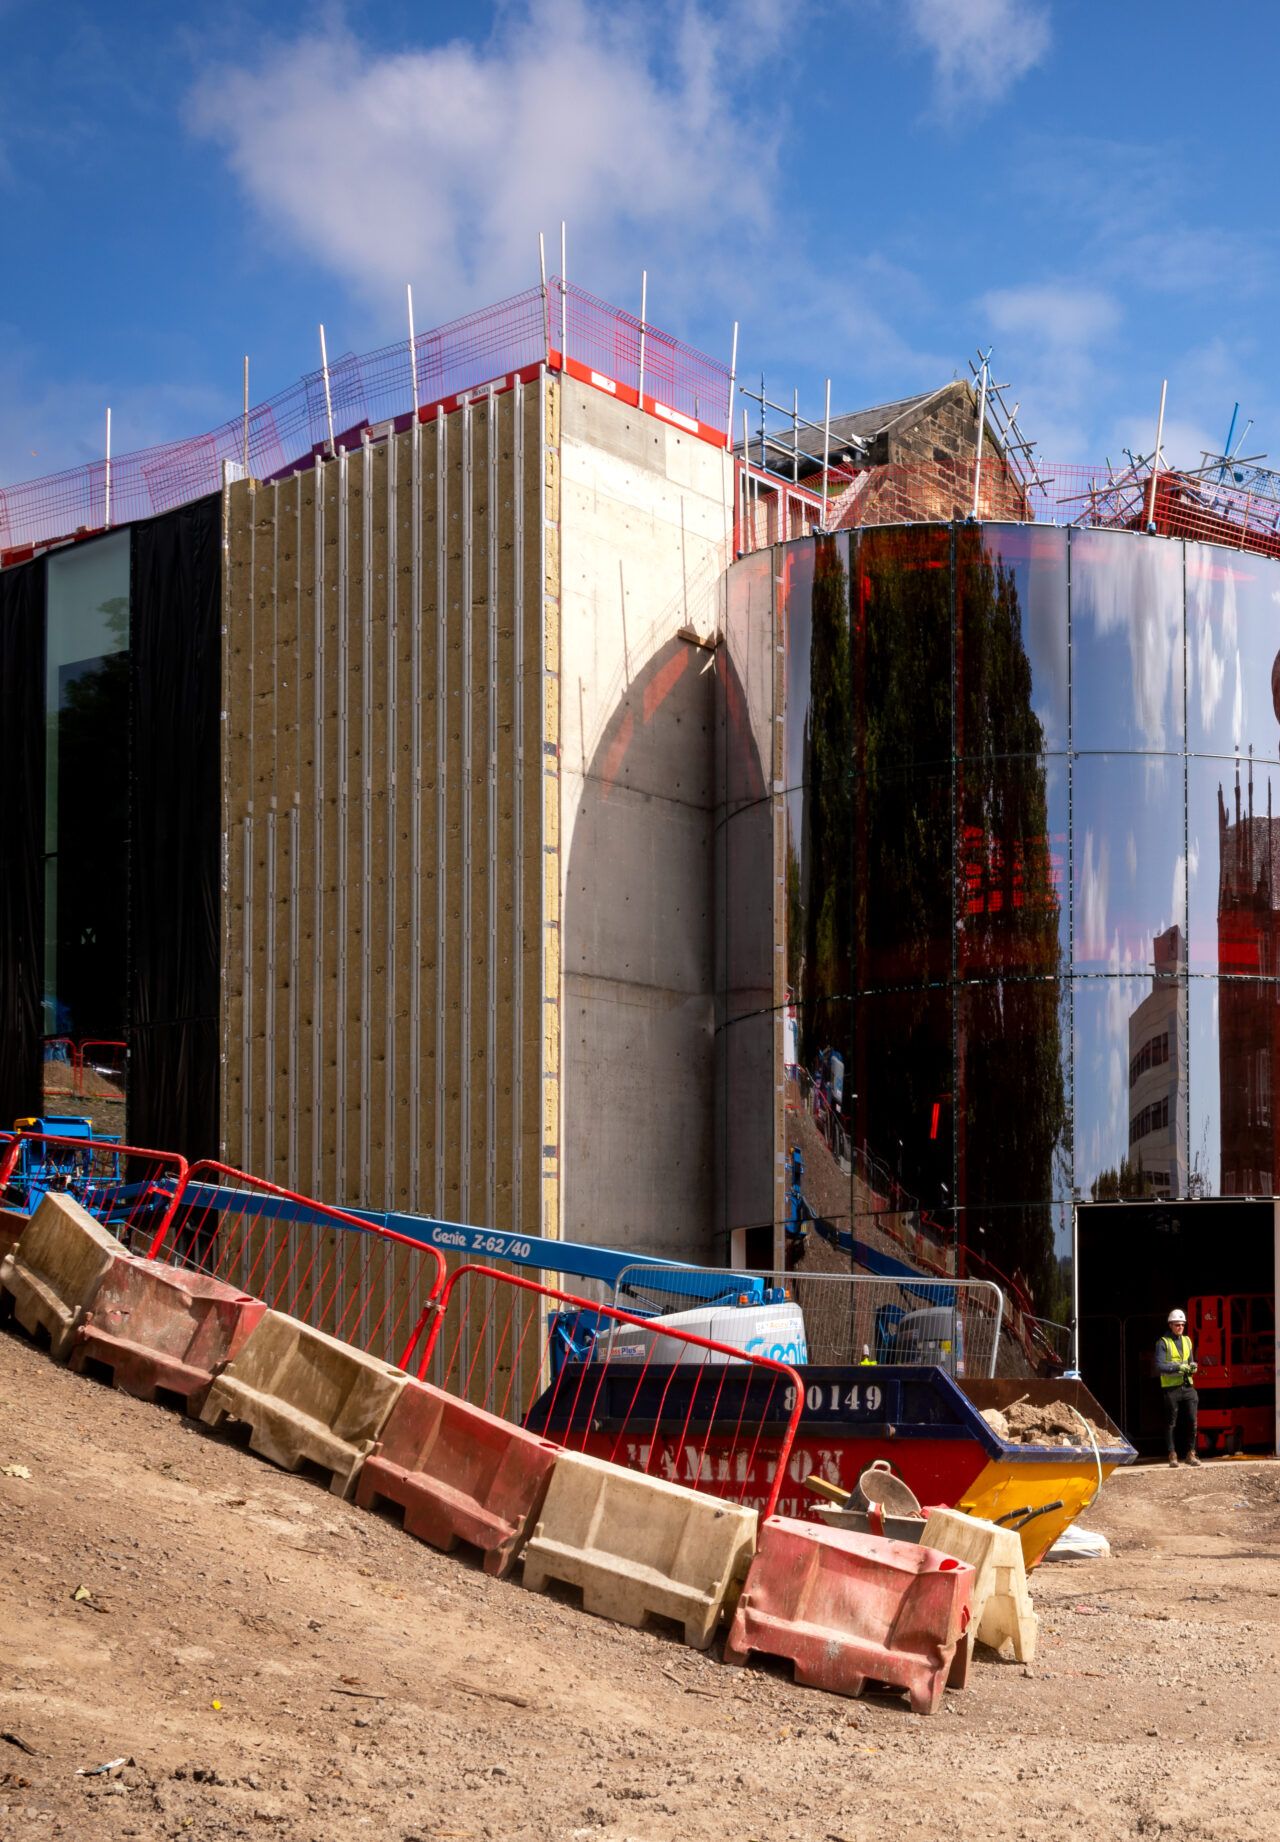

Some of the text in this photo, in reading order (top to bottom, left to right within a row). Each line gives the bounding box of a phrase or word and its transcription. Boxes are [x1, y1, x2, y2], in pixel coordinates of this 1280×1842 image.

[432, 1227, 531, 1258] Genie Z-62/40
[784, 1385, 882, 1411] 80149
